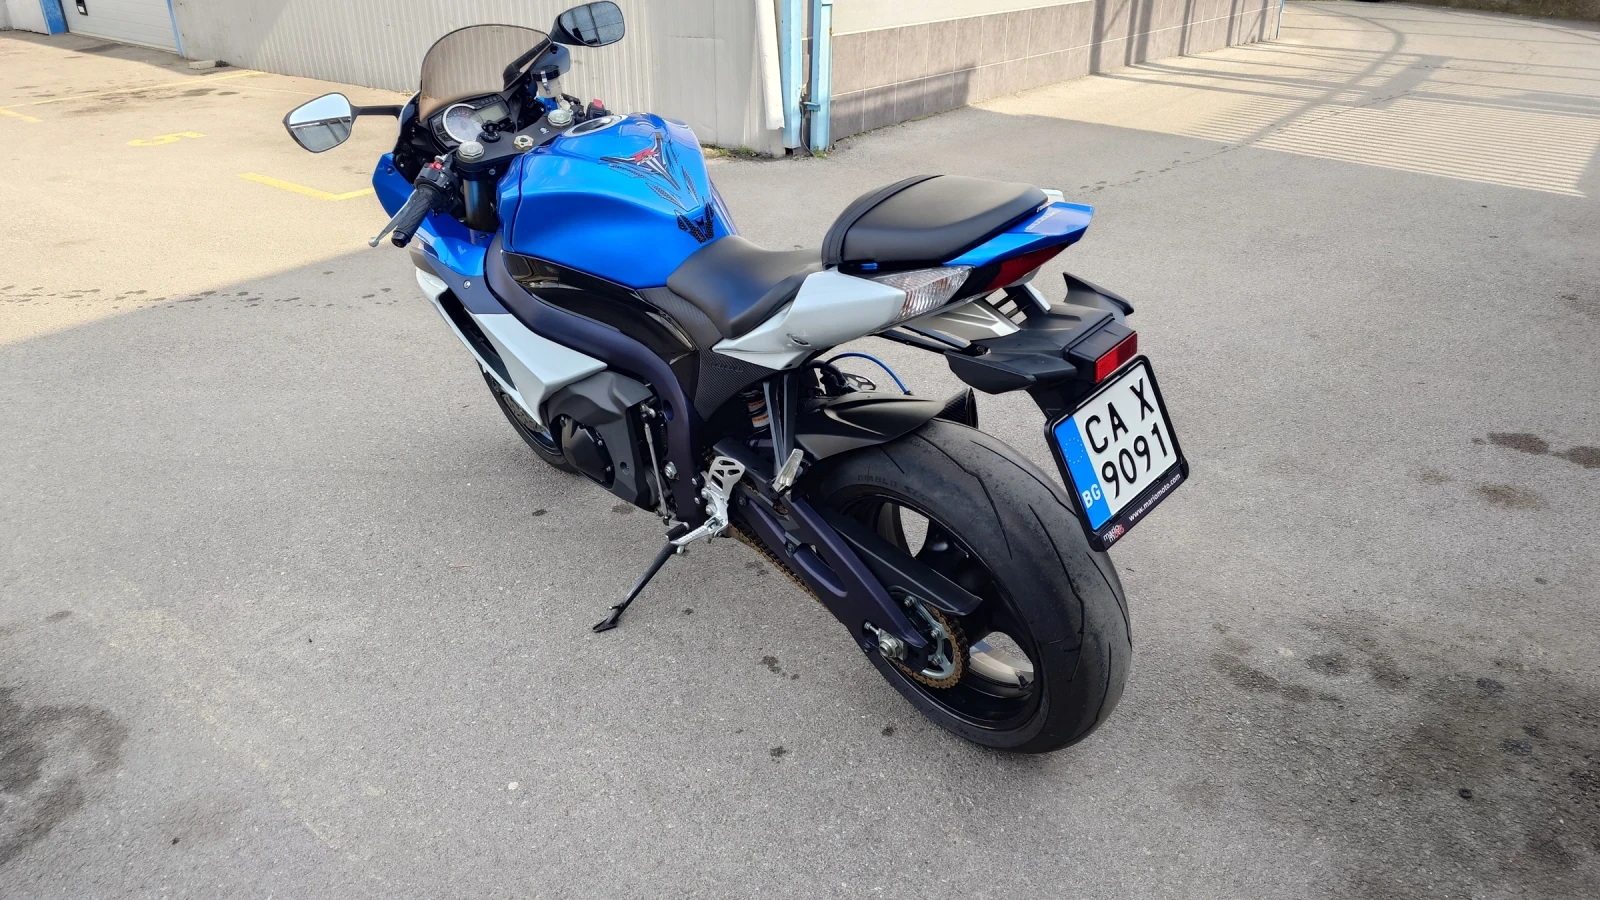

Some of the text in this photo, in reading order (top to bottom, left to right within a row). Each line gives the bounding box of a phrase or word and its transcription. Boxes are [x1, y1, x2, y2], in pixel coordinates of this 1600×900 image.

[1084, 377, 1155, 454] CA X
[1101, 421, 1168, 500] 9091
[1081, 483, 1102, 509] BG
[1128, 473, 1181, 522] www.mariomoto.com
